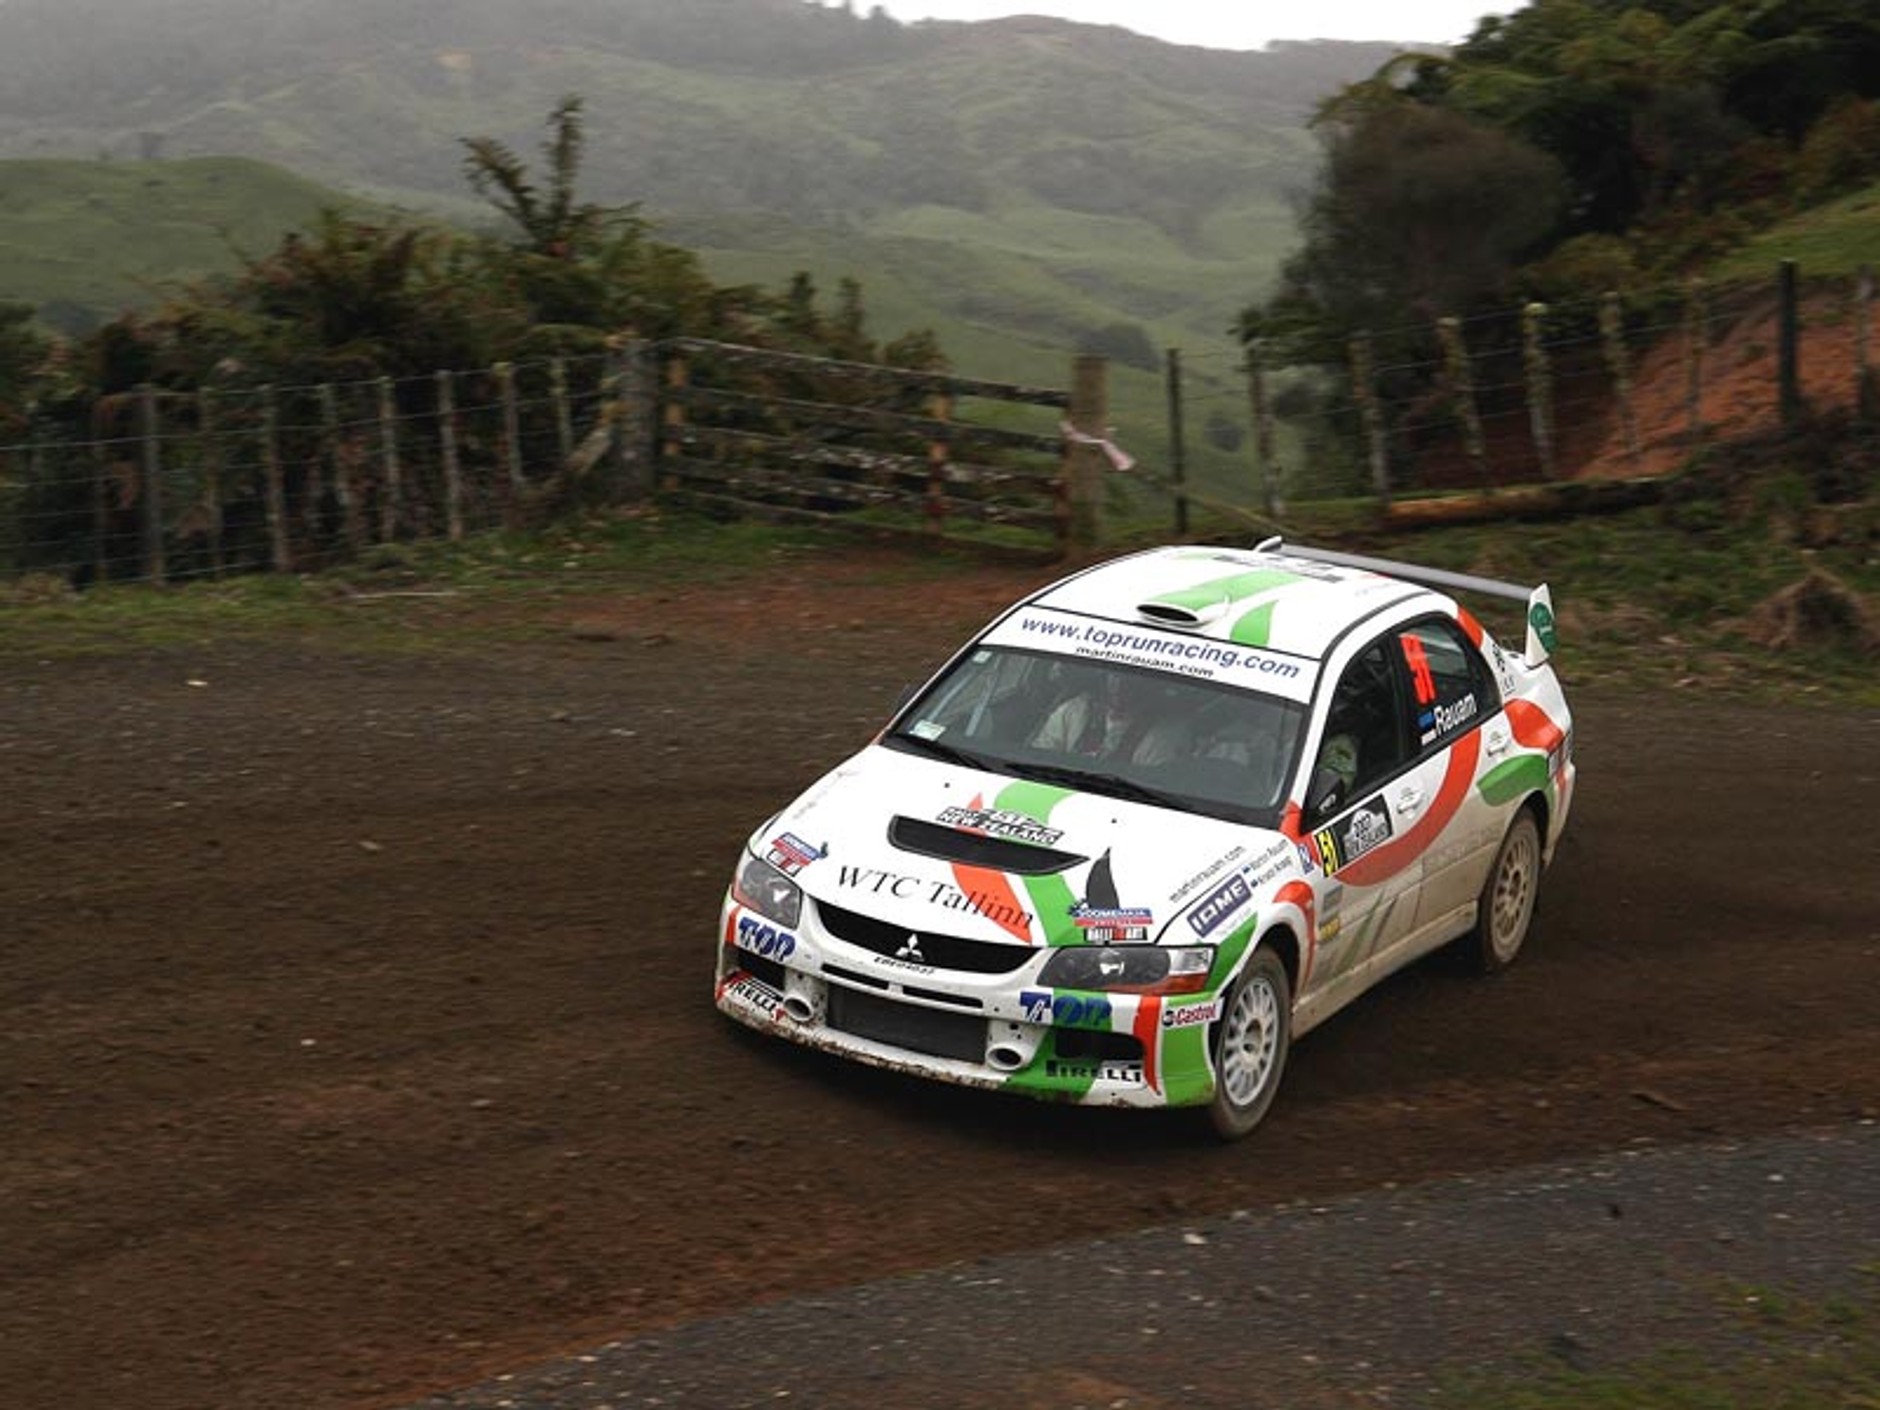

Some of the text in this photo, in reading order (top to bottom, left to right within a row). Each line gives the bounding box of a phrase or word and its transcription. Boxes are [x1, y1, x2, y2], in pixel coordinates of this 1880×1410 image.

[1021, 616, 1301, 679] www.toprunracing.com
[1075, 645, 1214, 678] martinrauam.com
[1433, 692, 1477, 735] Rauam
[837, 865, 1034, 929] WTC Tallinn
[738, 916, 797, 963] TOP
[1020, 992, 1113, 1026] TOP
[1176, 1003, 1216, 1025] Castrol
[1045, 1060, 1142, 1083] PIRELLI
